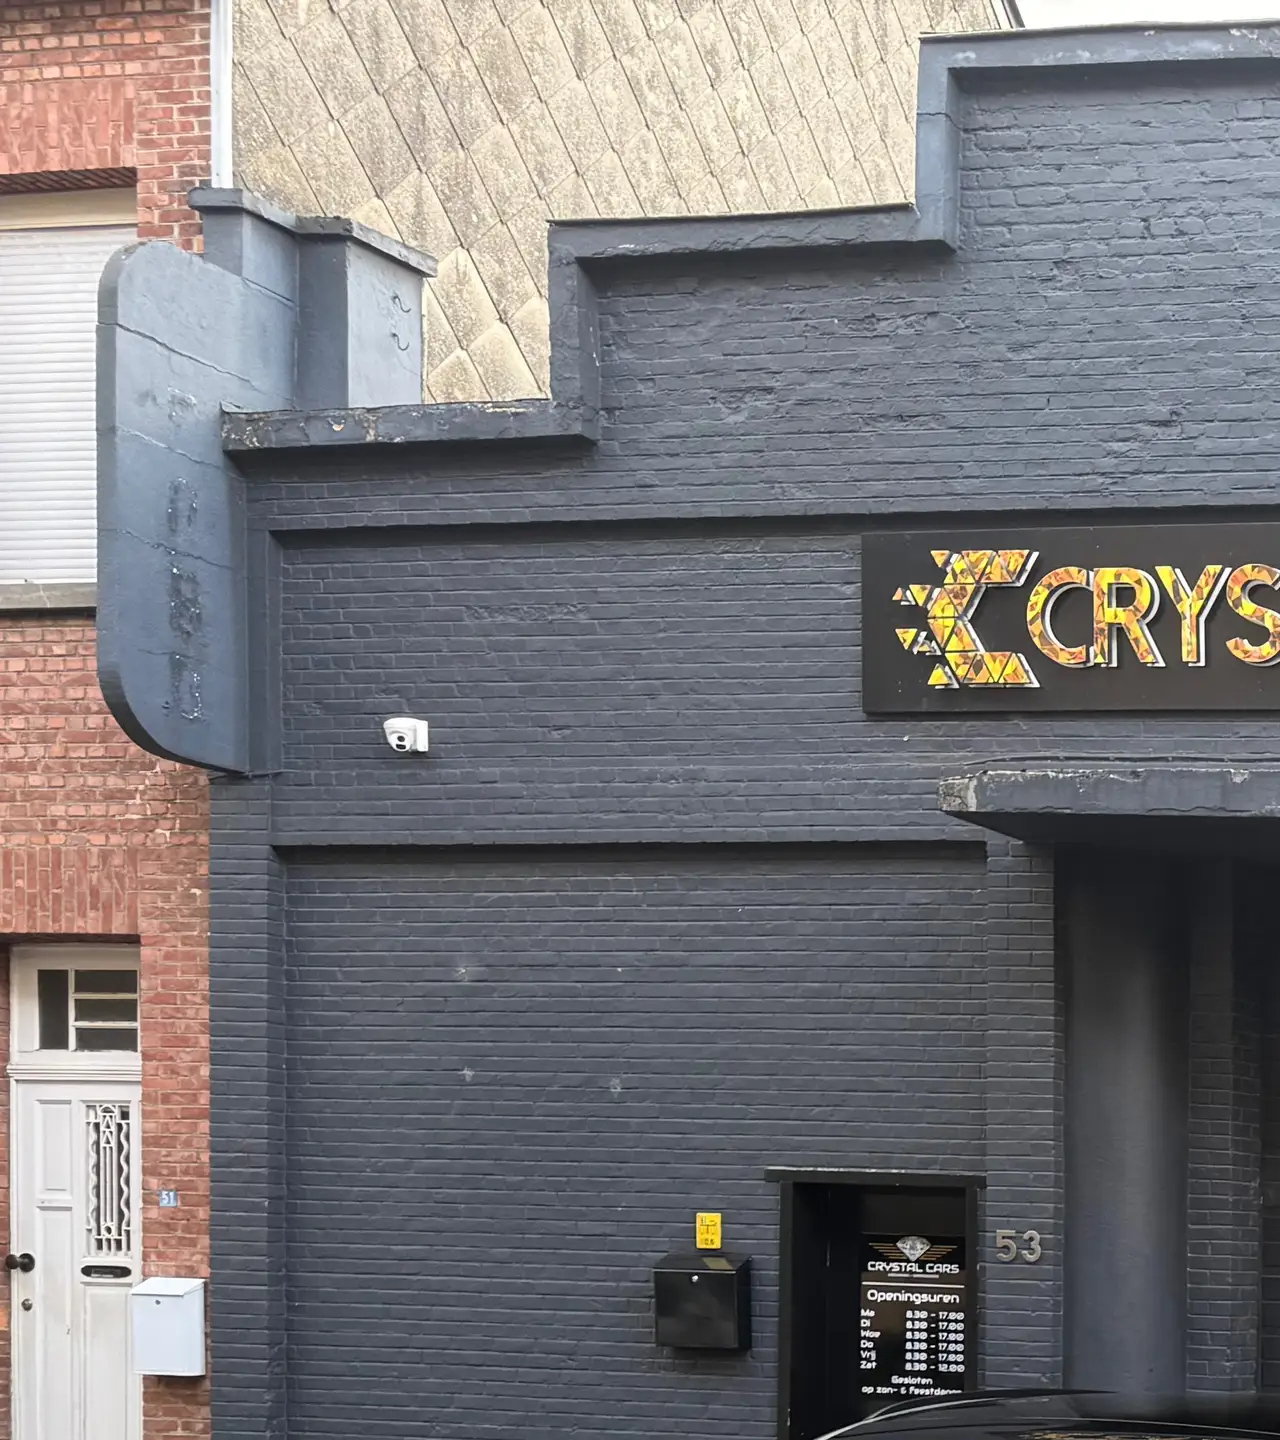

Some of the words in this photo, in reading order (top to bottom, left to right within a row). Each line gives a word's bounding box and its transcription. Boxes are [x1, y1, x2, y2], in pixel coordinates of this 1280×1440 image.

[161, 1190, 175, 1205] 51
[995, 1229, 1042, 1262] 53
[867, 1261, 924, 1273] CRYSTAL
[925, 1263, 960, 1274] CARS
[866, 1289, 960, 1305] Openingsuren
[861, 1319, 871, 1327] Di
[860, 1360, 877, 1369] Zat
[891, 1375, 933, 1385] Gesloten
[861, 1386, 874, 1394] op
